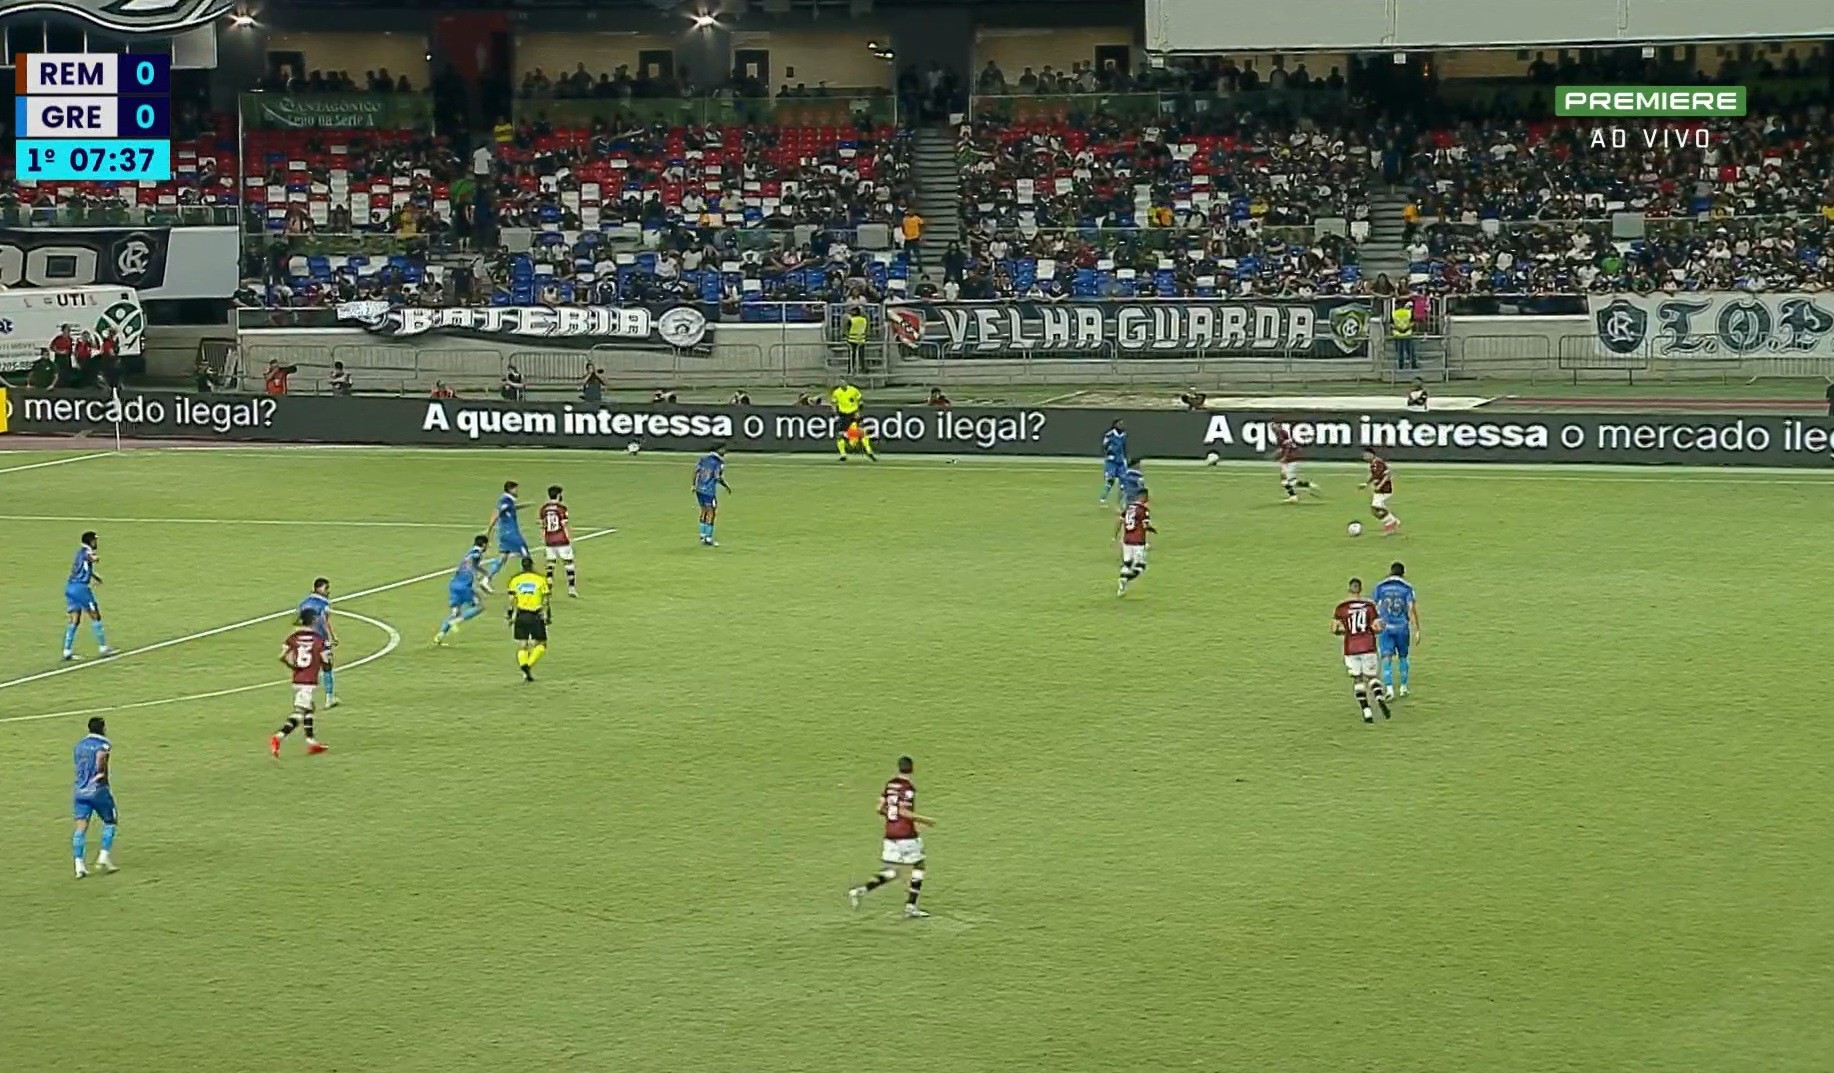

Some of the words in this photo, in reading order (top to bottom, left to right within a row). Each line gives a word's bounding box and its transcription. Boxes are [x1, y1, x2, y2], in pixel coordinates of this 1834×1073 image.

[56, 293, 87, 306] UTI
[937, 305, 1103, 352] VELHA
[1116, 304, 1315, 352] GUARDA
[25, 396, 164, 424] mercado
[175, 396, 277, 433] ilegal?
[422, 402, 450, 431] A
[456, 407, 556, 439] quem
[563, 405, 733, 437] interessa
[743, 414, 764, 438] o
[775, 411, 925, 439] merado
[937, 411, 1046, 447] ilegal?
[1203, 414, 1234, 445] A
[1360, 415, 1549, 448] interessa
[1561, 424, 1585, 449] o
[1598, 419, 1770, 451] mercado
[1350, 608, 1368, 634] 14
